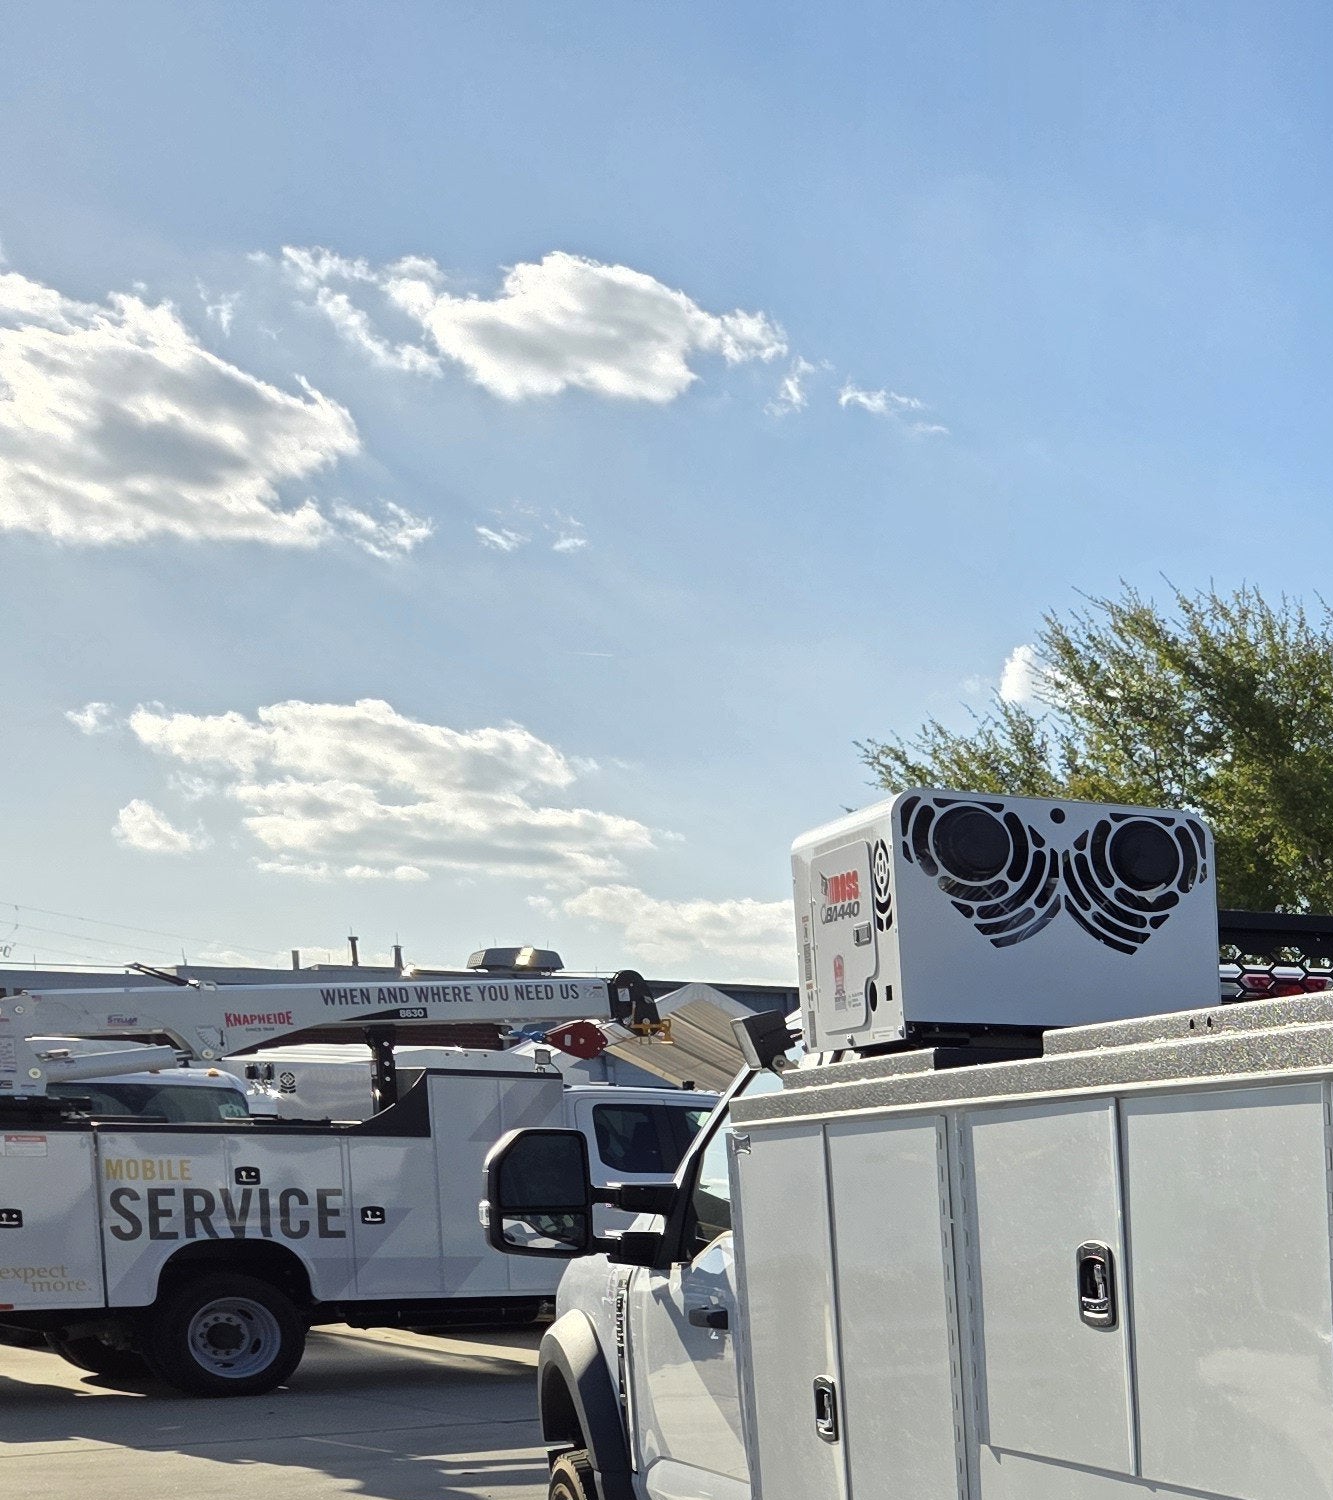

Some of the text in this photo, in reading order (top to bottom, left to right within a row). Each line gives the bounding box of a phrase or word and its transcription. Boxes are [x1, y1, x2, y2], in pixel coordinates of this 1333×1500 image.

[320, 988, 372, 1006] WHEN
[377, 987, 410, 1004] AND
[414, 985, 472, 1003] WHERE
[477, 985, 510, 1001] YOU
[515, 983, 554, 1000] NEED
[559, 983, 580, 1000] US
[224, 1011, 294, 1028] KNAPHEIDE
[105, 1158, 192, 1181] MOBILE
[109, 1187, 347, 1241] SERVICE
[0, 1264, 69, 1284] expect
[32, 1277, 92, 1293] more.
